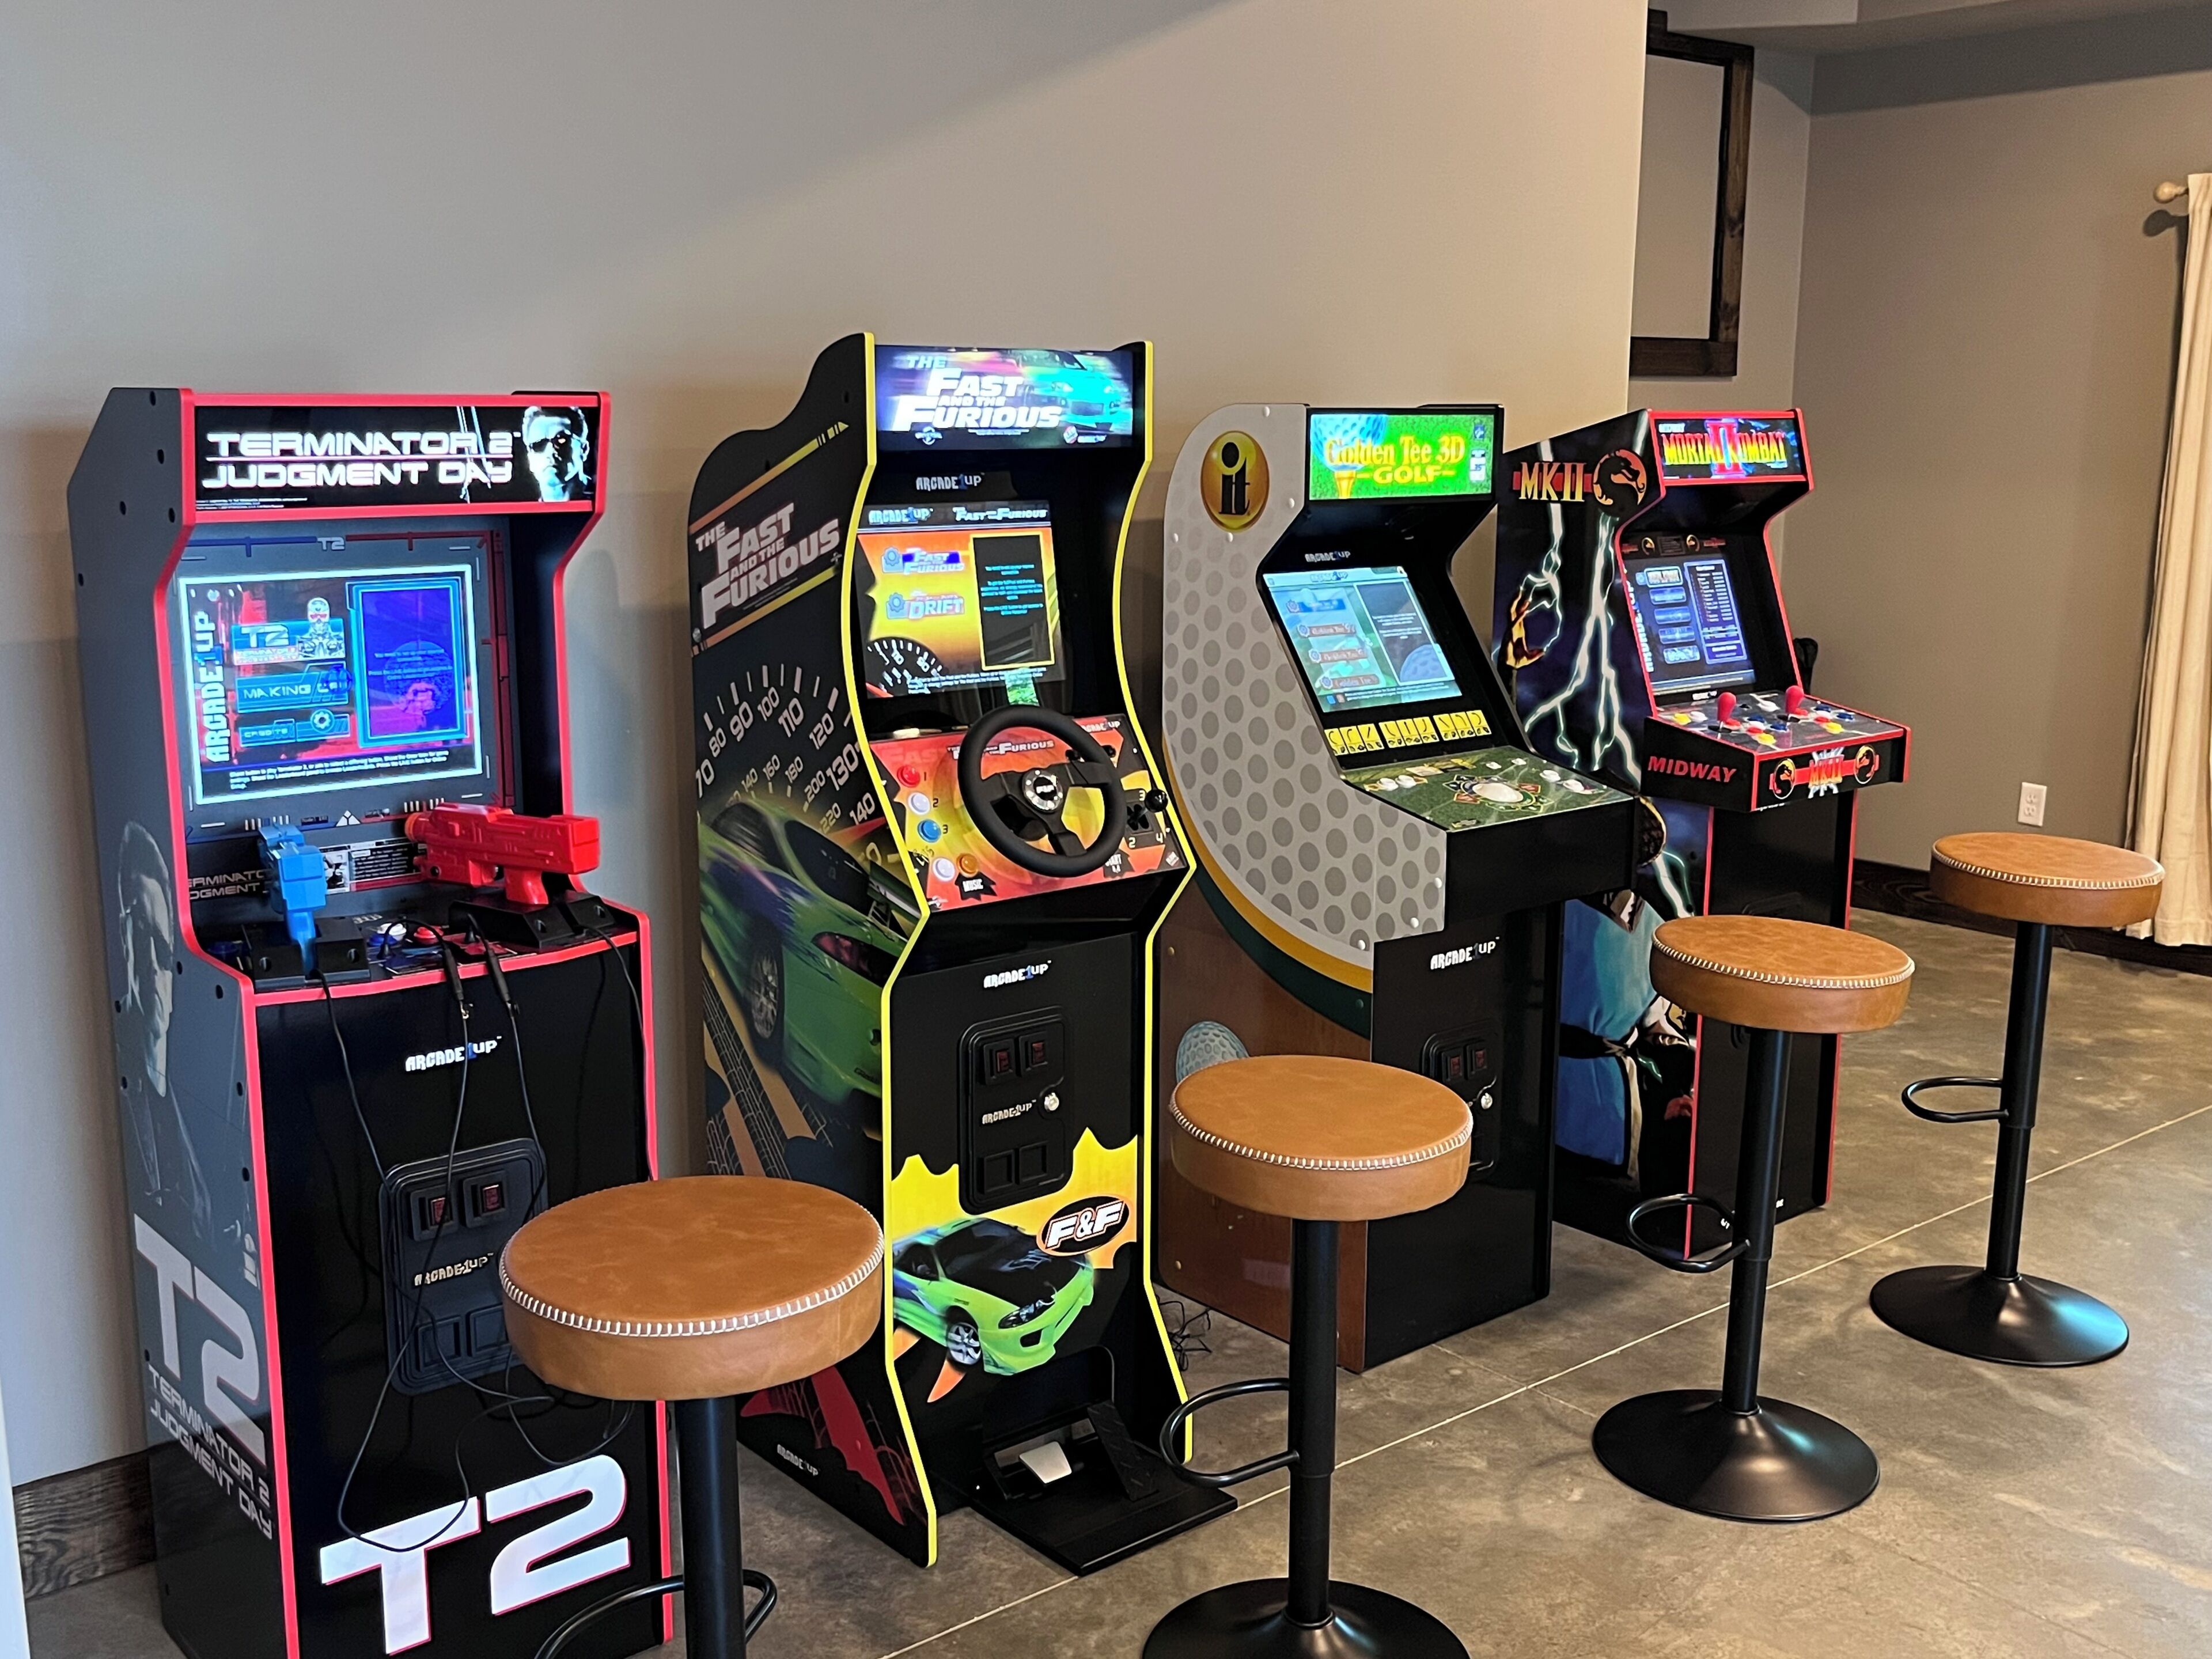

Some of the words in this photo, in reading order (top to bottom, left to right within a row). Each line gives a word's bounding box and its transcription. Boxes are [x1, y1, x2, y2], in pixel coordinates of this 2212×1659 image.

[907, 355, 947, 369] THE
[926, 368, 1024, 397] FAST
[892, 395, 1062, 433] FURIOUS
[206, 432, 478, 456] TERMINATOR
[490, 432, 513, 454] 2
[1325, 439, 1396, 465] Golden
[1399, 435, 1432, 464] Tee
[1436, 435, 1465, 464] 3D
[1661, 433, 1722, 465] MORTAL
[202, 463, 428, 488] JUDGMENT
[438, 461, 512, 486] DAY
[916, 474, 982, 491] ARCADE1UP
[1373, 465, 1444, 484] GOLF
[317, 536, 346, 550] T2
[696, 521, 725, 552] THE
[717, 503, 794, 574] FAST
[702, 518, 839, 629] FURIOUS
[731, 555, 757, 581] AND
[760, 537, 785, 561] THE
[909, 599, 964, 619] DRIFT
[241, 624, 289, 648] T2
[194, 610, 232, 763] ARCADE1UP
[244, 684, 311, 699] MAKING
[757, 687, 779, 721] 100
[778, 698, 804, 737] 110
[730, 702, 753, 741] 90
[809, 713, 834, 749] 120
[709, 728, 726, 757] 80
[999, 740, 1055, 755] FURIOUS
[741, 768, 758, 793] 140
[763, 755, 780, 780] 160
[785, 756, 804, 783] 180
[826, 744, 859, 791] 130
[1647, 756, 1737, 782] MIDWAY
[805, 770, 825, 804] 200
[1138, 790, 1146, 801] 3
[850, 793, 875, 825] 140
[933, 798, 939, 808] 2
[820, 803, 841, 834] 220
[942, 824, 948, 834] 3
[1128, 837, 1136, 848] 2
[1156, 832, 1163, 843] 4
[1430, 941, 1495, 970] ARCADE1UP
[983, 963, 1049, 988] ARCADE1UP
[405, 1038, 498, 1072] ARCADE1UP
[1046, 1202, 1124, 1249] F&F
[134, 1214, 267, 1467] T2
[148, 1363, 255, 1491] TERMINATOR
[258, 1467, 270, 1508] 2
[150, 1399, 234, 1496] JUDGMENT
[238, 1486, 272, 1540] DAY
[320, 1454, 631, 1656] T2
